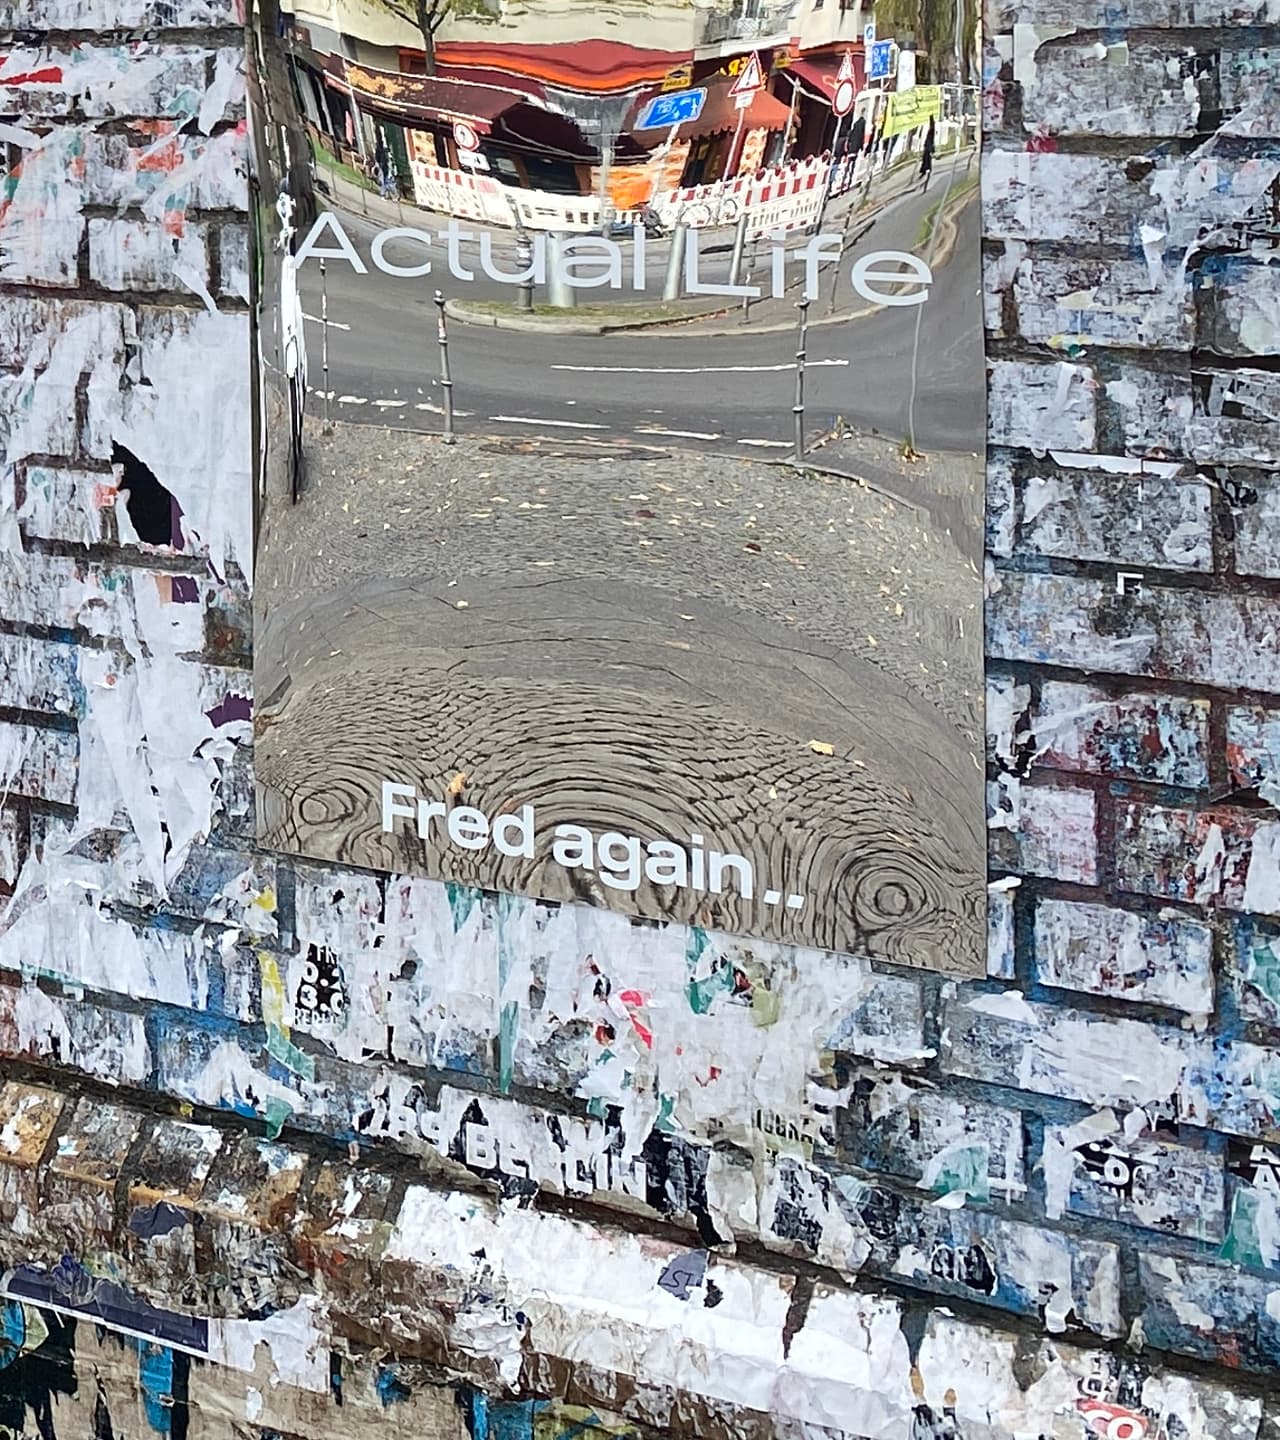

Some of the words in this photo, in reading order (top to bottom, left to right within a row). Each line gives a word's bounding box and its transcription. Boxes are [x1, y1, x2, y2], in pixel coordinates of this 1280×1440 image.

[294, 210, 647, 292] Actual
[683, 227, 936, 307] Life
[380, 780, 537, 859] Fred
[552, 822, 806, 910] again..
